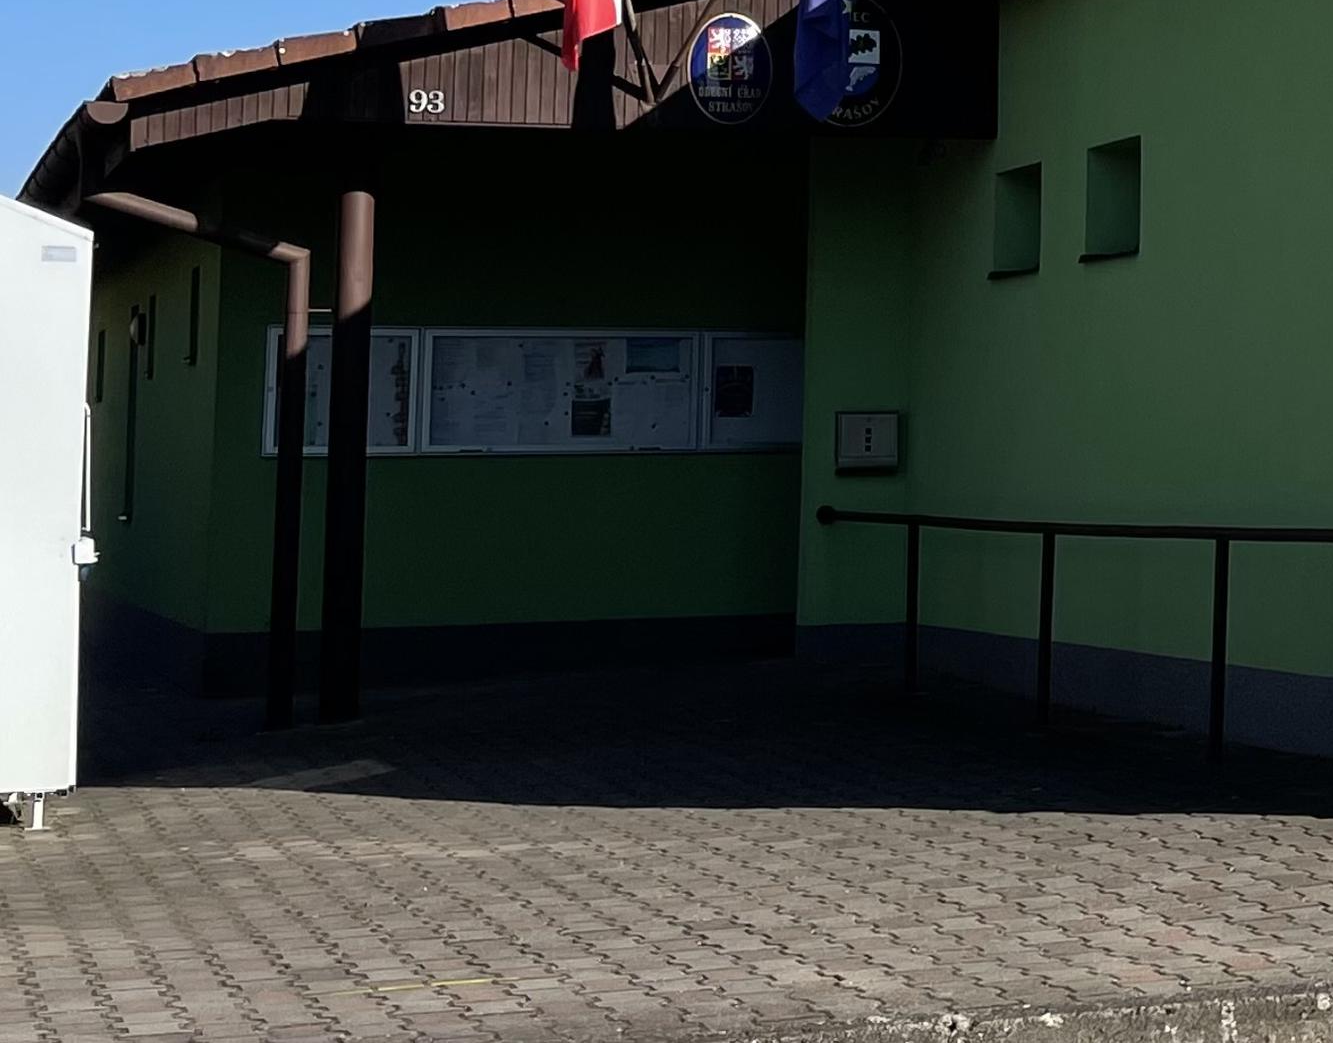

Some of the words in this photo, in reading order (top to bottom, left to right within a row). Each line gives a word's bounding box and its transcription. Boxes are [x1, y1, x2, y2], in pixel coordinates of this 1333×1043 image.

[409, 89, 445, 114] 93
[708, 99, 754, 113] STRAŠOV
[831, 95, 881, 121] RAŠOV
